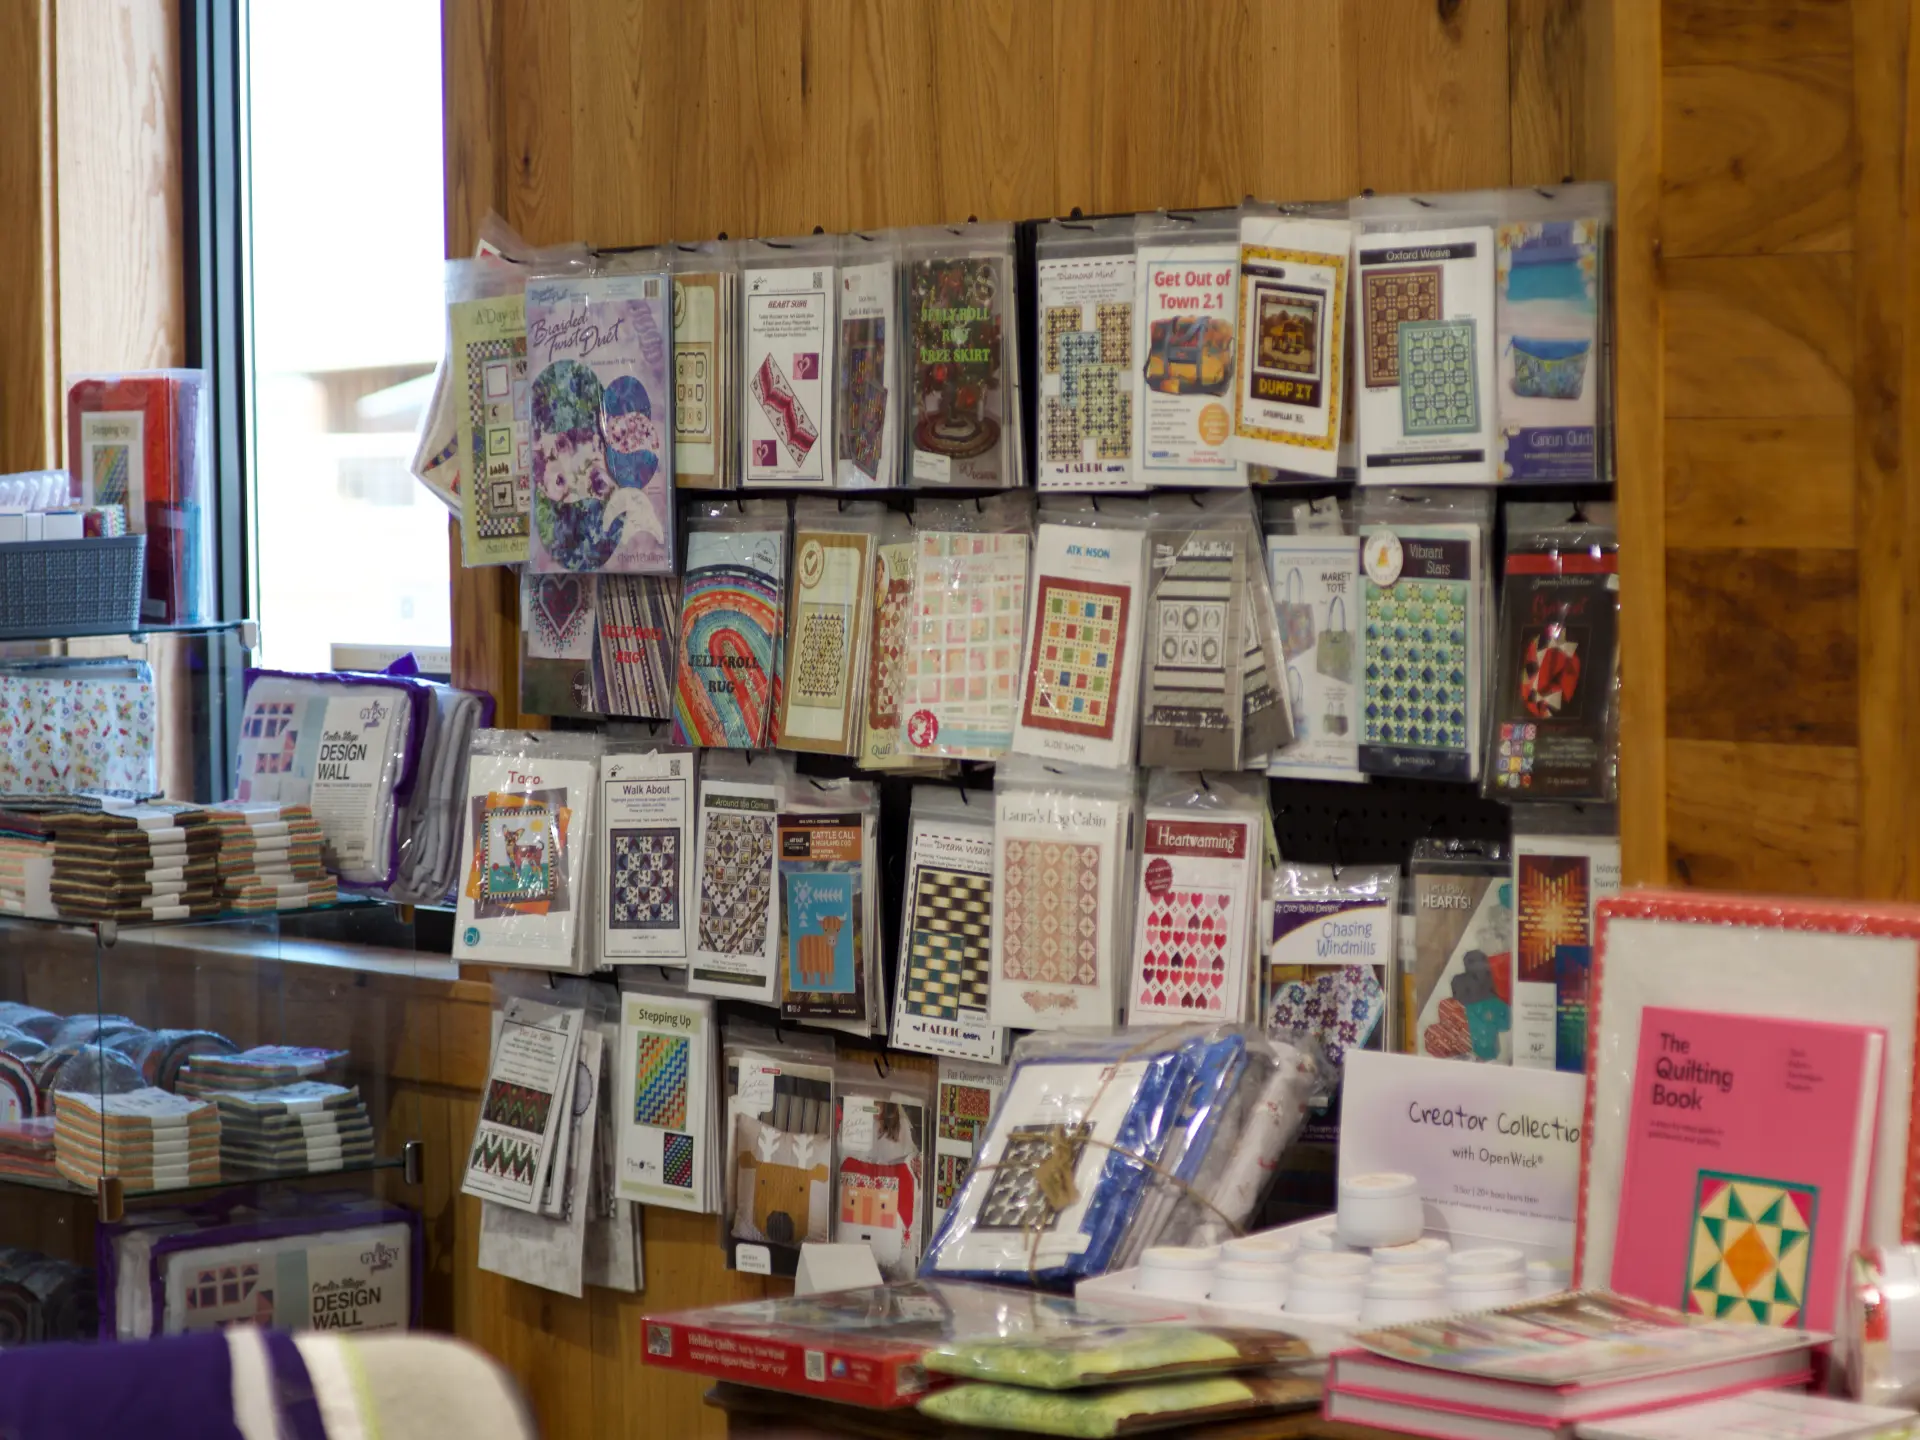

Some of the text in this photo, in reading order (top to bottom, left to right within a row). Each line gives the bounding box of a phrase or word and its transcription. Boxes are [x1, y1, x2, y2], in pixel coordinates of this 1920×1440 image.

[1386, 248, 1451, 261] Oxford Weave
[1154, 268, 1232, 287] Get Out of
[768, 301, 790, 309] HEART
[1159, 293, 1224, 309] Town 2.1
[487, 306, 507, 328] Day
[531, 308, 588, 347] Bearded
[543, 317, 625, 361] Twist Duet
[920, 348, 991, 362] TREE SKIRT
[1259, 378, 1313, 401] DUMP IT
[1531, 430, 1593, 446] Cancun Clutch
[1066, 544, 1111, 559] ATKINSON
[1409, 543, 1443, 559] Vibrant
[1321, 571, 1352, 581] MARKET
[1426, 561, 1450, 575] Stars
[1326, 582, 1347, 593] TOTE
[602, 624, 633, 639] JELLY
[688, 654, 759, 669] JELLY ROLL
[708, 680, 735, 693] RUG
[360, 707, 388, 720] GYPSY
[320, 744, 367, 761] DESIGN
[318, 762, 350, 780] WALL
[508, 771, 541, 785] Taco
[623, 785, 670, 795] Walk About
[715, 798, 738, 808] Around
[1002, 806, 1045, 823] Laura's
[1072, 811, 1107, 828] Cabin
[811, 831, 856, 839] CATTLE CALL
[1157, 826, 1236, 854] Heartwarming
[1447, 884, 1465, 896] Play
[1284, 904, 1297, 913] Cozy
[1299, 904, 1315, 914] Quilt
[1421, 895, 1473, 909] HEARTS!
[1322, 921, 1372, 939] Chasing
[1316, 939, 1377, 958] Windmills
[639, 1009, 691, 1029] Stepping Up
[1659, 1032, 1690, 1055] The
[960, 1070, 985, 1083] Quarter
[1655, 1055, 1734, 1093] Quilting
[1652, 1083, 1702, 1111] Book
[1408, 1100, 1581, 1143] Creator Collectio
[1452, 1145, 1475, 1161] with
[1490, 1190, 1506, 1200] hour
[1507, 1192, 1523, 1203] burn
[1524, 1195, 1540, 1204] time
[360, 1248, 400, 1265] GYPSY
[313, 1287, 381, 1313] DESIGN
[313, 1309, 363, 1331] WALL
[688, 1333, 714, 1348] Holiday
